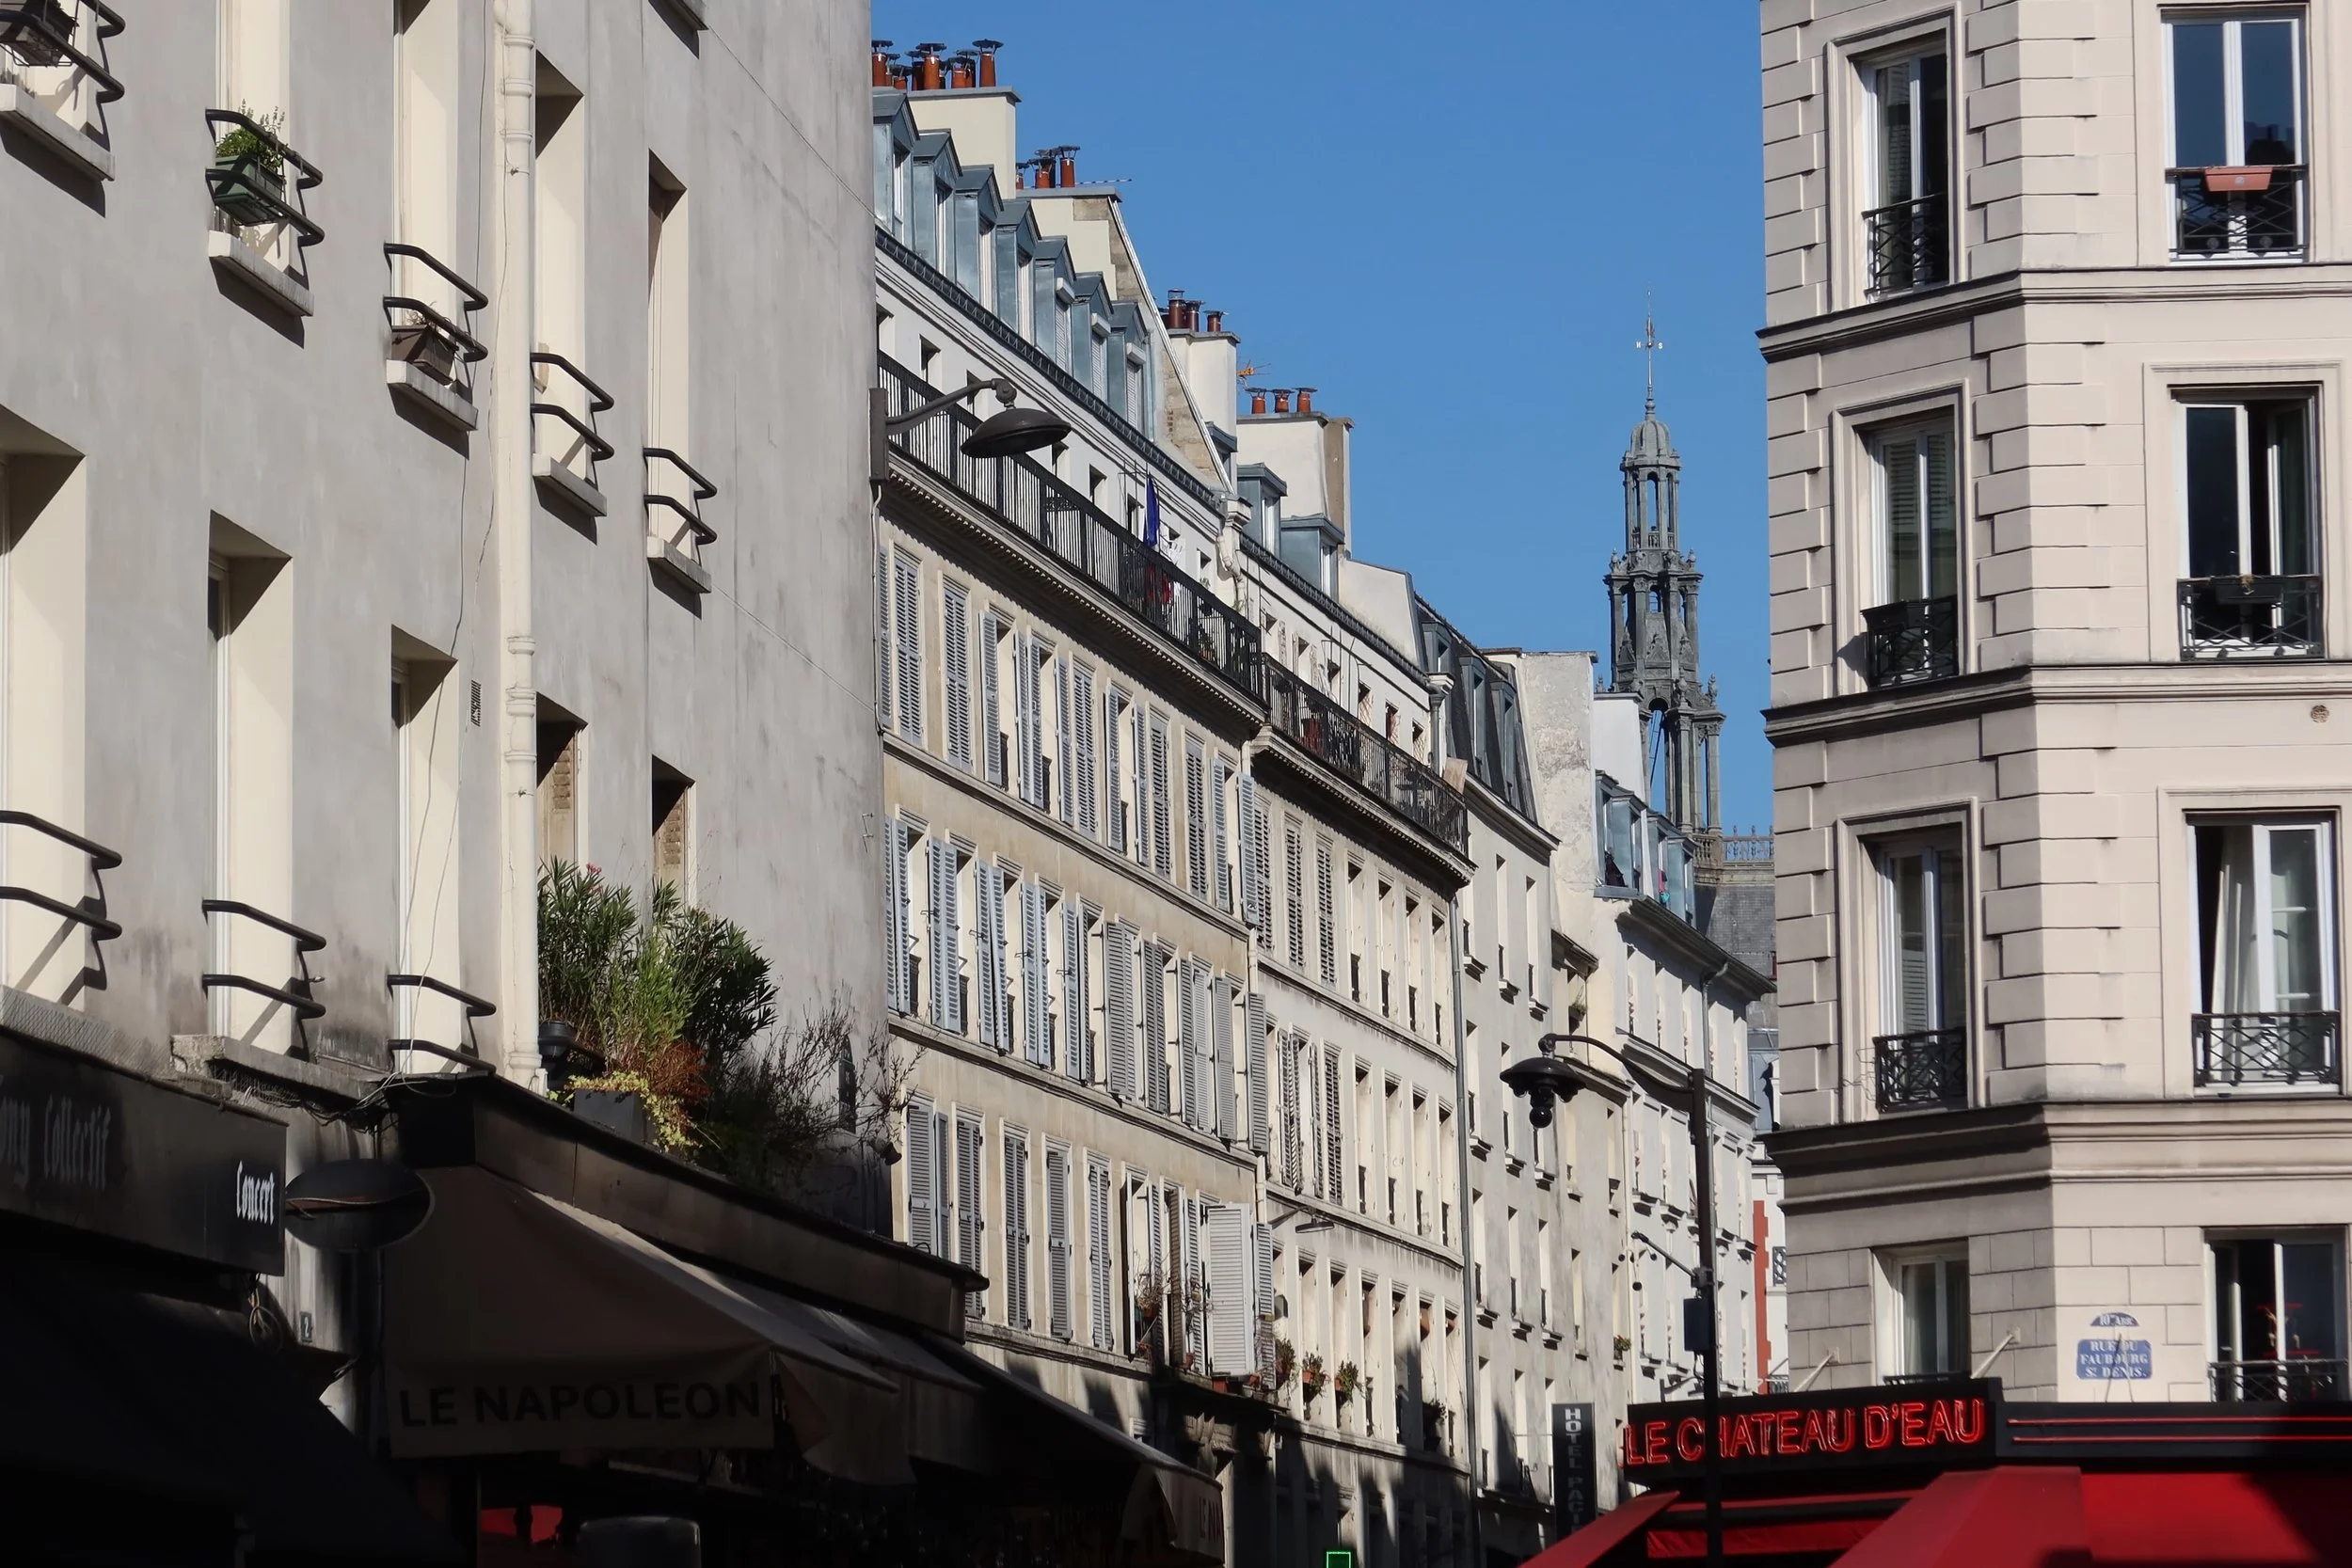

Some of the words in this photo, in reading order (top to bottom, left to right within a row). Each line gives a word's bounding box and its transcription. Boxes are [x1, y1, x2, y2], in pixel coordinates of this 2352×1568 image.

[304, 1316, 310, 1338] 2
[2080, 1354, 2149, 1365] FAUBOURG
[2090, 1340, 2116, 1352] RUE
[400, 1386, 457, 1427] LE
[473, 1381, 760, 1422] NAPOLEON
[1565, 1407, 1582, 1469] HOTEL
[1623, 1420, 1670, 1467] LE
[1864, 1398, 1987, 1450] D'EAU
